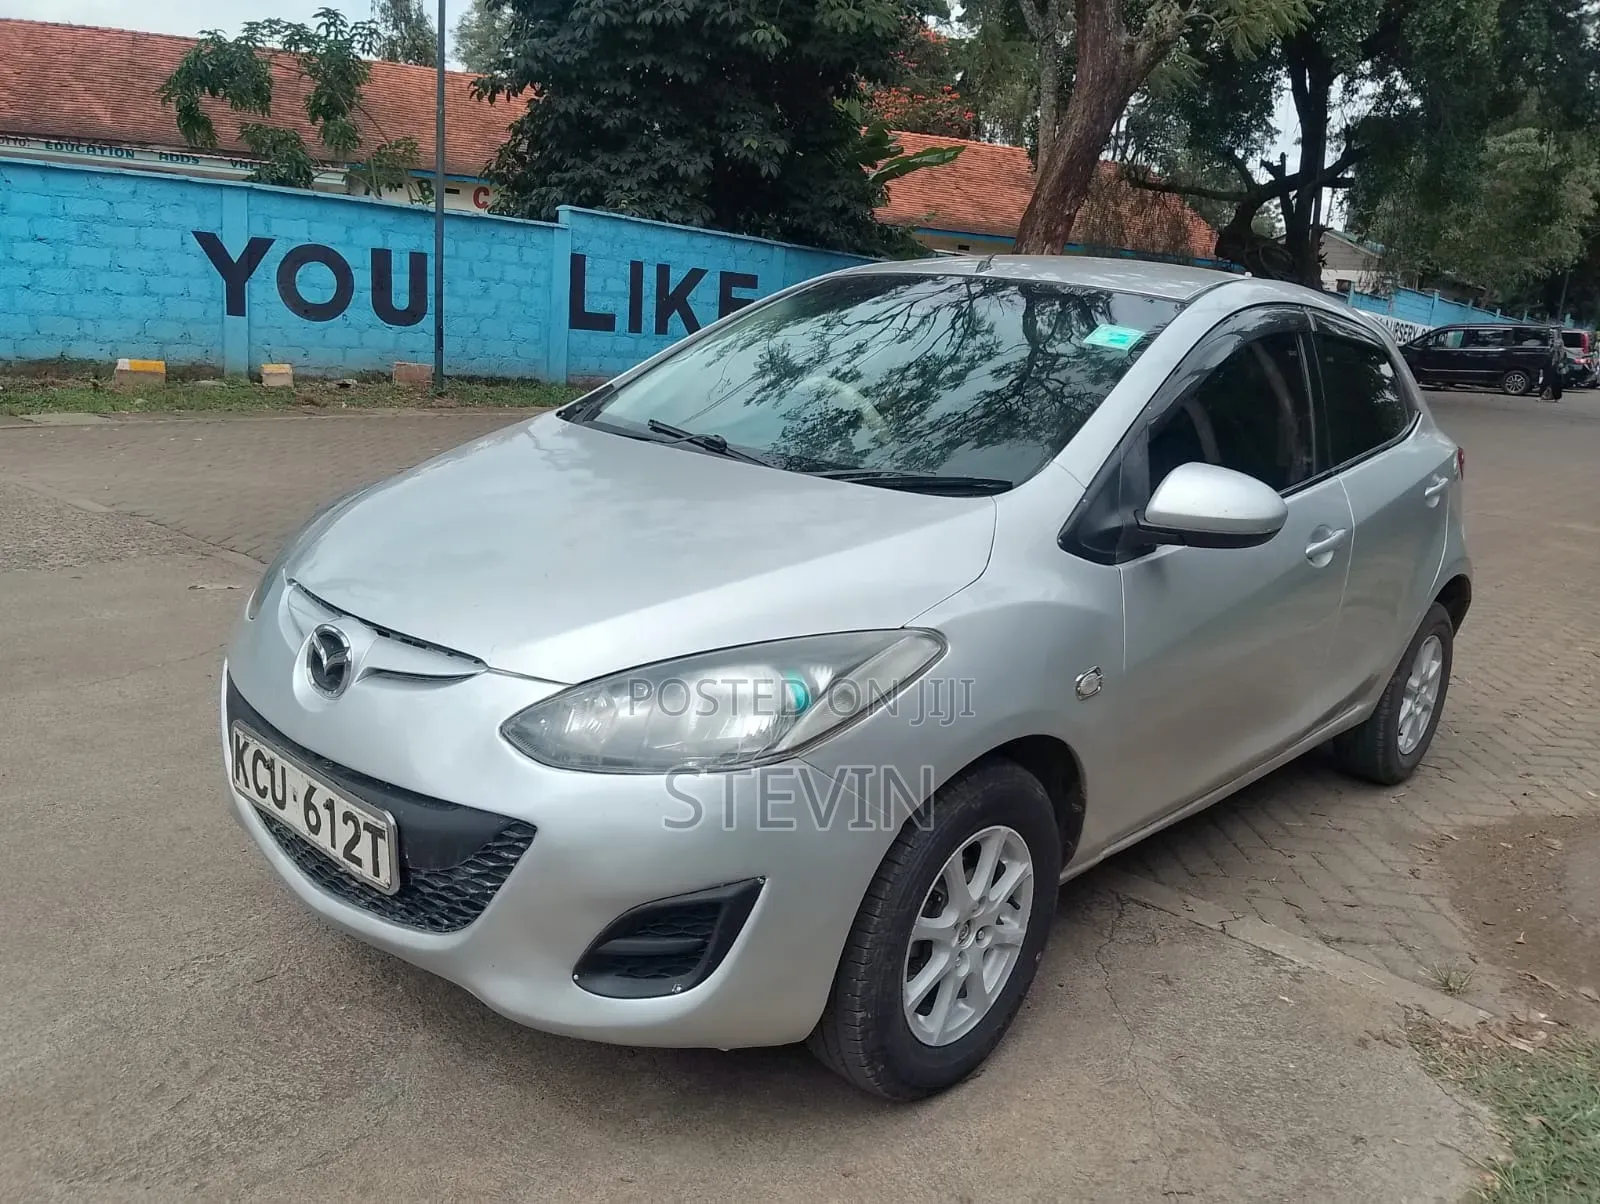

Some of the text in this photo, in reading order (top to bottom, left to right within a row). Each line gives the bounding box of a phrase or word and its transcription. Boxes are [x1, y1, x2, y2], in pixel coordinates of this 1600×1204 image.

[45, 141, 135, 158] EDUCATION
[159, 153, 199, 164] ADDS
[191, 230, 758, 335] YOU LIKE
